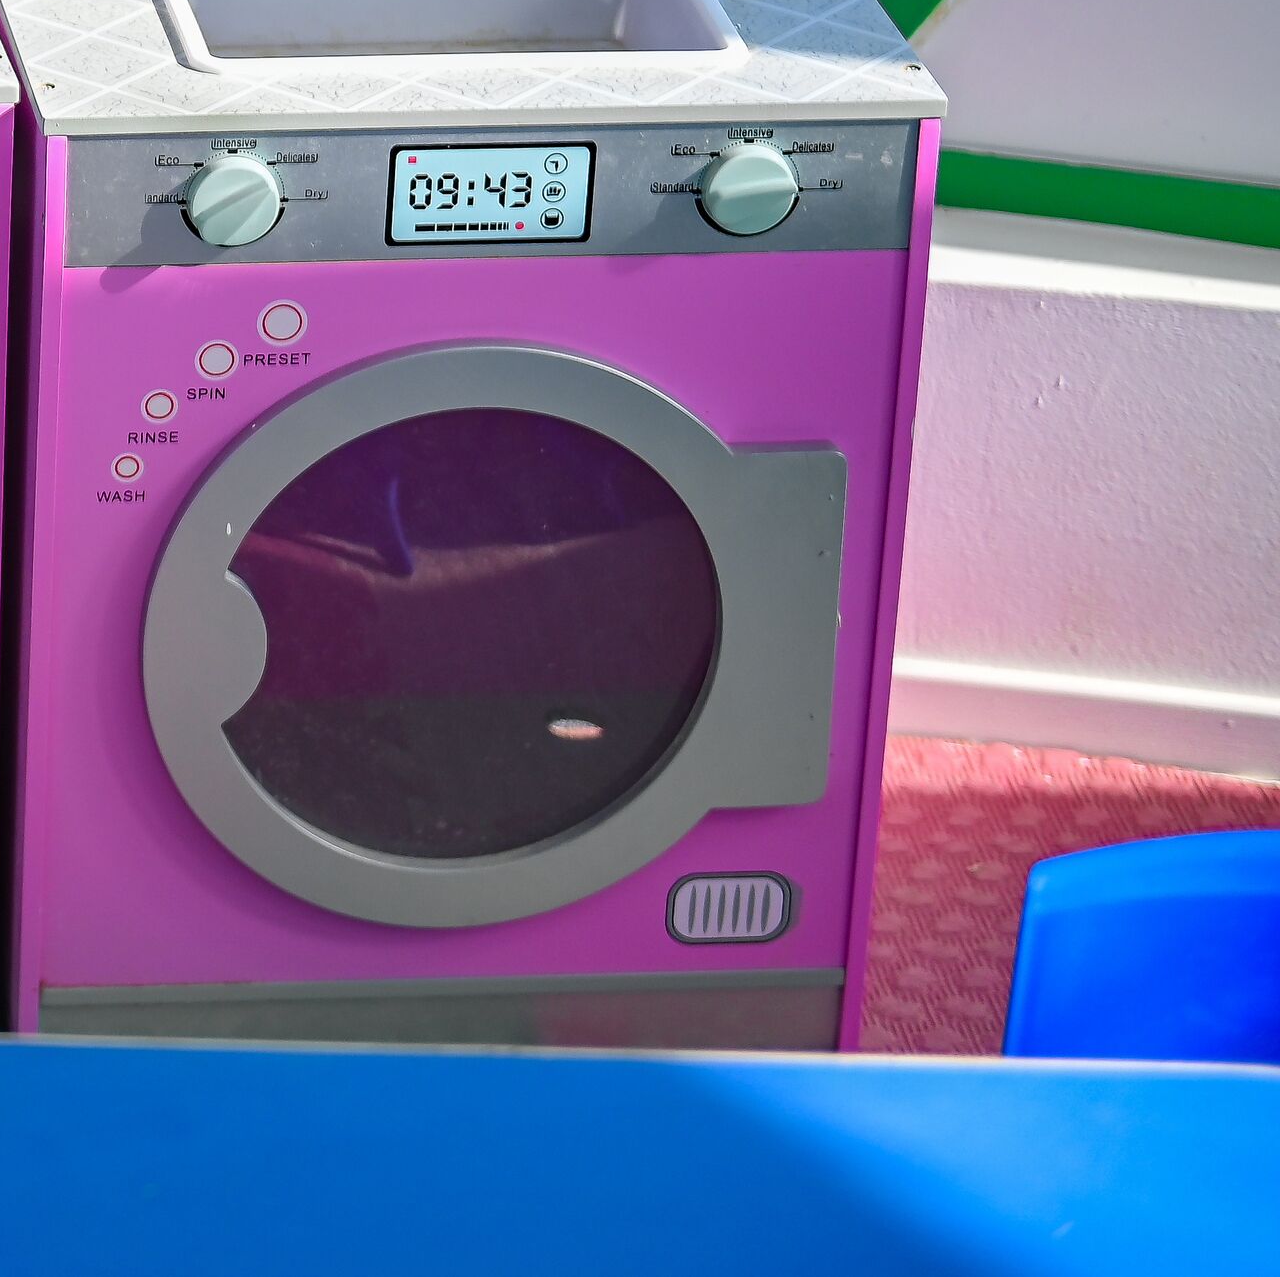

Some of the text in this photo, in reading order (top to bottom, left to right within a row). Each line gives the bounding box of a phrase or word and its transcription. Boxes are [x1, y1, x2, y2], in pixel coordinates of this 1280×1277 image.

[730, 127, 772, 137] Intensive
[213, 138, 256, 148] Intensive
[792, 141, 832, 153] Delicates
[674, 144, 696, 154] Eco
[158, 155, 180, 165] Eco
[276, 152, 317, 163] Delicates
[653, 182, 693, 192] Standard
[820, 179, 838, 189] Dry
[305, 189, 323, 200] Dry
[408, 171, 533, 210] 09:43
[243, 352, 312, 366] PRESET
[186, 387, 227, 401] SPIN
[127, 431, 179, 444] RINSE
[96, 490, 146, 503] WASH
